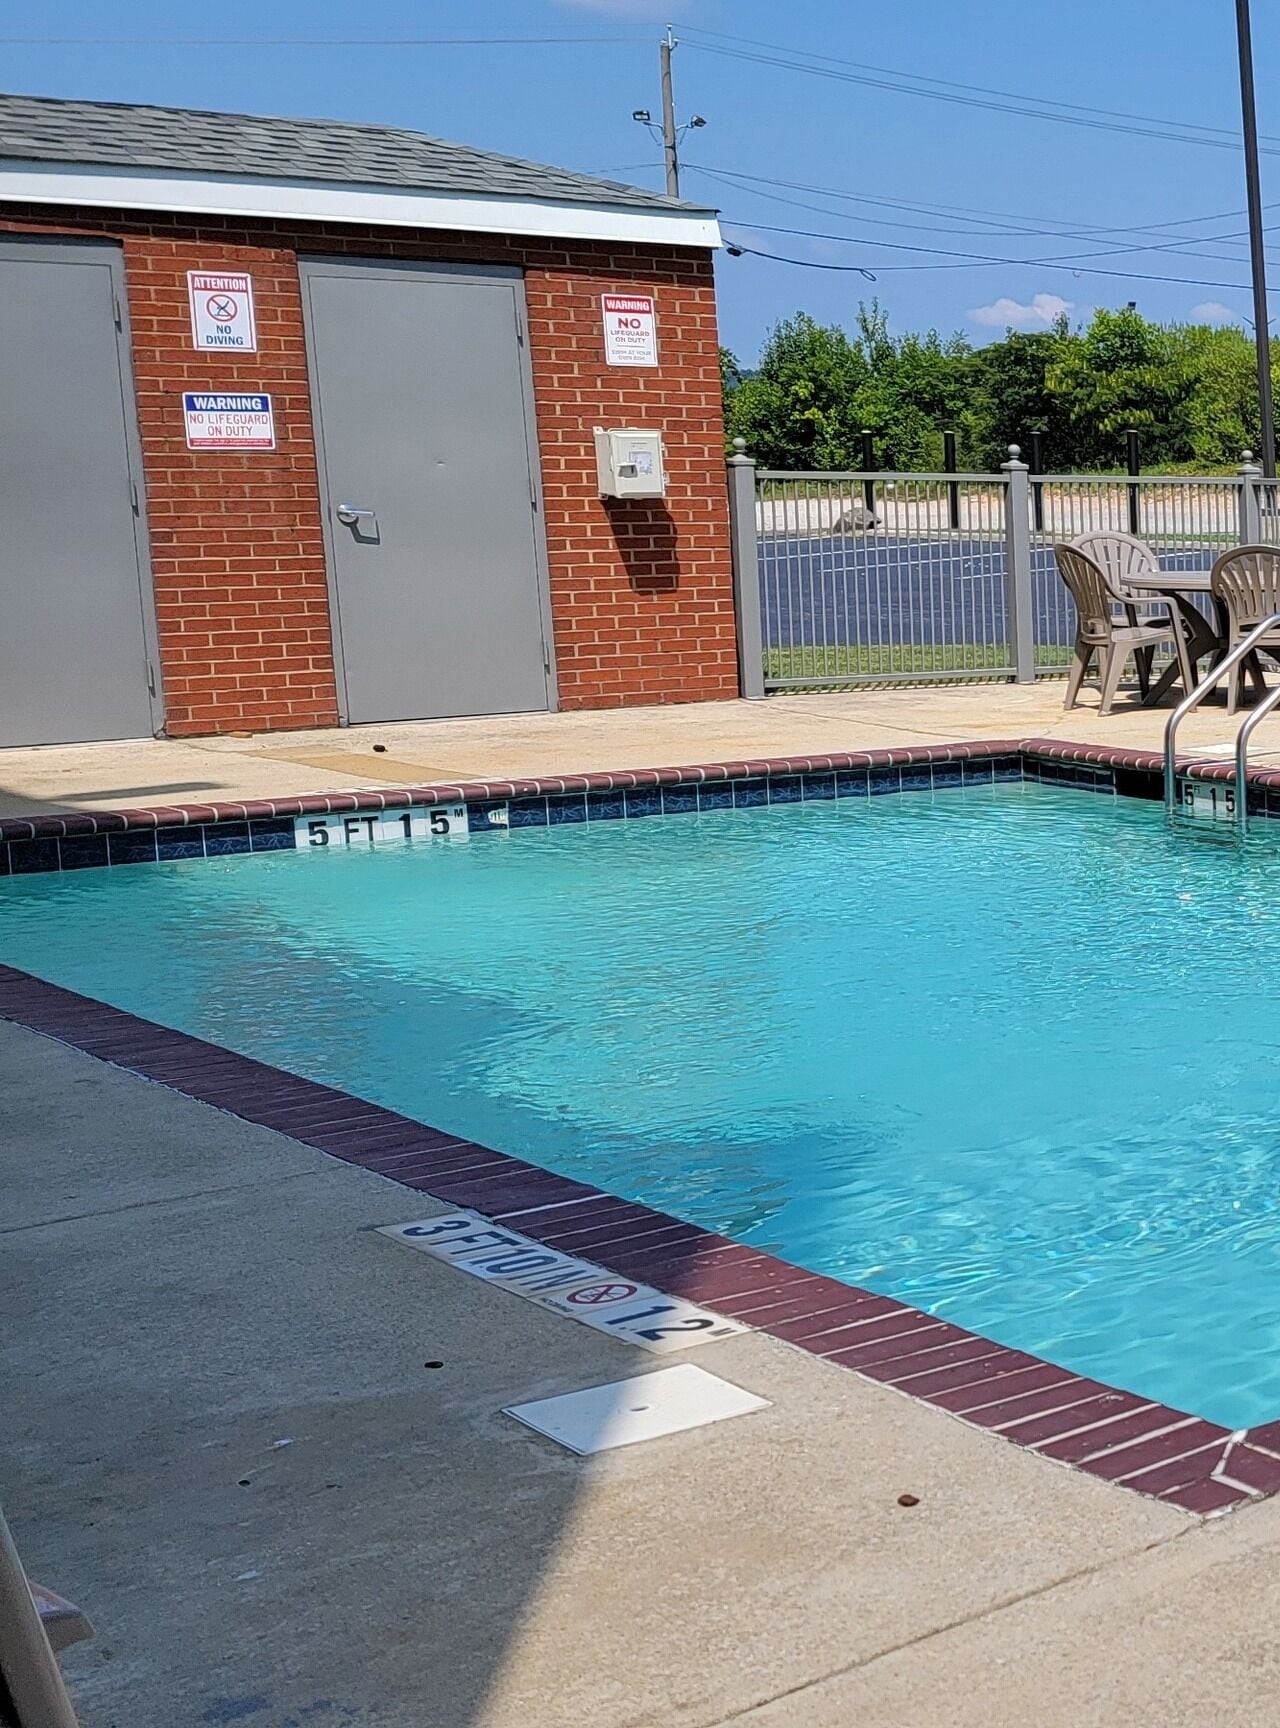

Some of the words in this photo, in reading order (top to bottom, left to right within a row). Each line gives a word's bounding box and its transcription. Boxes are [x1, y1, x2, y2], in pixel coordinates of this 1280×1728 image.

[194, 276, 246, 290] ATTENTION
[606, 299, 650, 311] WARNING
[216, 325, 232, 334] NO
[618, 318, 641, 329] NO
[206, 336, 244, 345] DIVING
[193, 397, 262, 410] WARNING
[189, 414, 204, 424] NO
[207, 414, 268, 425] LIFEGUARD
[207, 426, 222, 436] ON
[225, 426, 253, 436] DUTY
[1184, 784, 1194, 805] 5
[308, 820, 329, 847] 5
[343, 815, 379, 843] FT
[402, 1220, 471, 1237] 3
[428, 1230, 523, 1255] FT
[506, 1264, 601, 1292] IN
